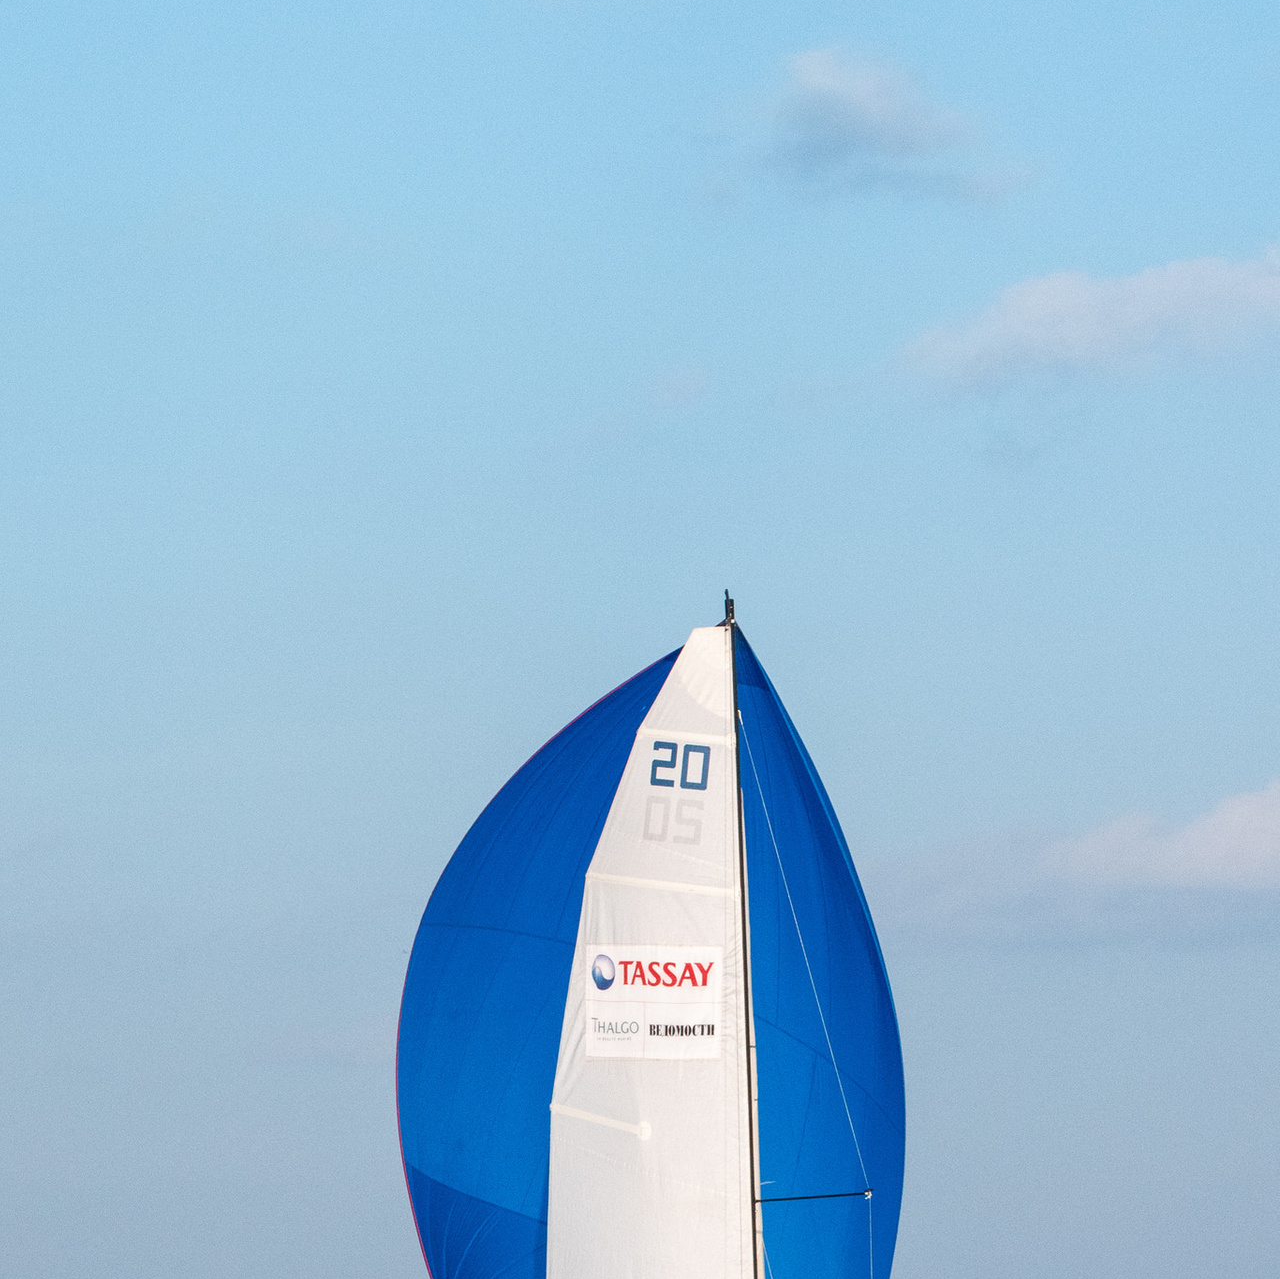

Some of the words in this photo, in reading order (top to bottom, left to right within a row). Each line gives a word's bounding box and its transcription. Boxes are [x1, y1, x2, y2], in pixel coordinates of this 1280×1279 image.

[650, 740, 711, 790] 20
[618, 960, 714, 987] TASSAY
[591, 1017, 640, 1034] THALGO
[649, 1024, 715, 1037] ВЕДОМОСТИ
